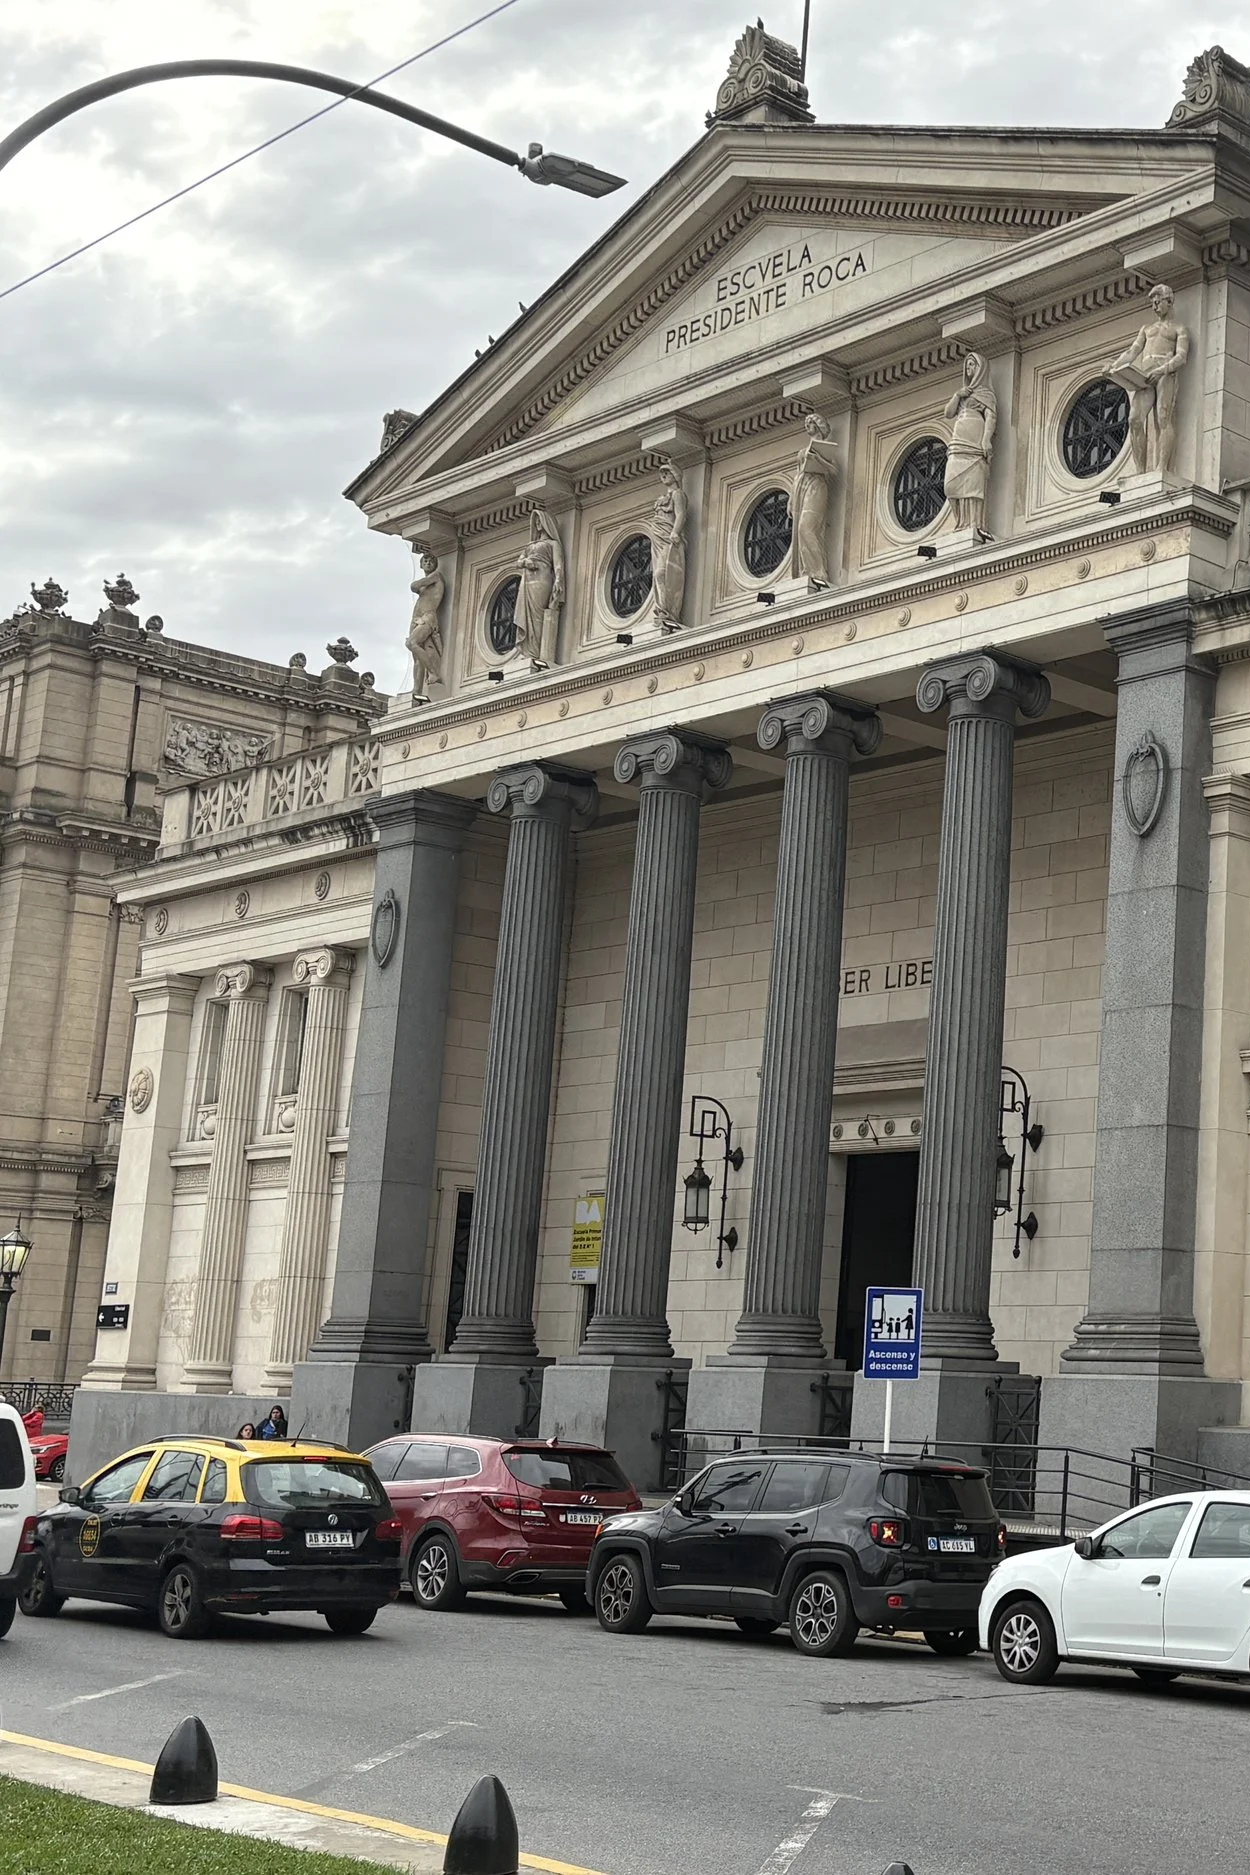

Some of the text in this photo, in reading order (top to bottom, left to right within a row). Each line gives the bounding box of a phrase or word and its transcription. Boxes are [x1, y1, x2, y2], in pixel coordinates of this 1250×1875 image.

[715, 243, 813, 303] ESCVELA
[664, 252, 867, 353] PRESIDENTE ROCA
[884, 960, 933, 989] LIBE
[575, 1200, 601, 1225] BA
[868, 1350, 916, 1361] Ascenso y
[869, 1361, 913, 1370] descenso
[579, 1515, 592, 1523] 457
[954, 1523, 968, 1531] Jeep
[308, 1534, 350, 1543] AB 316 PY
